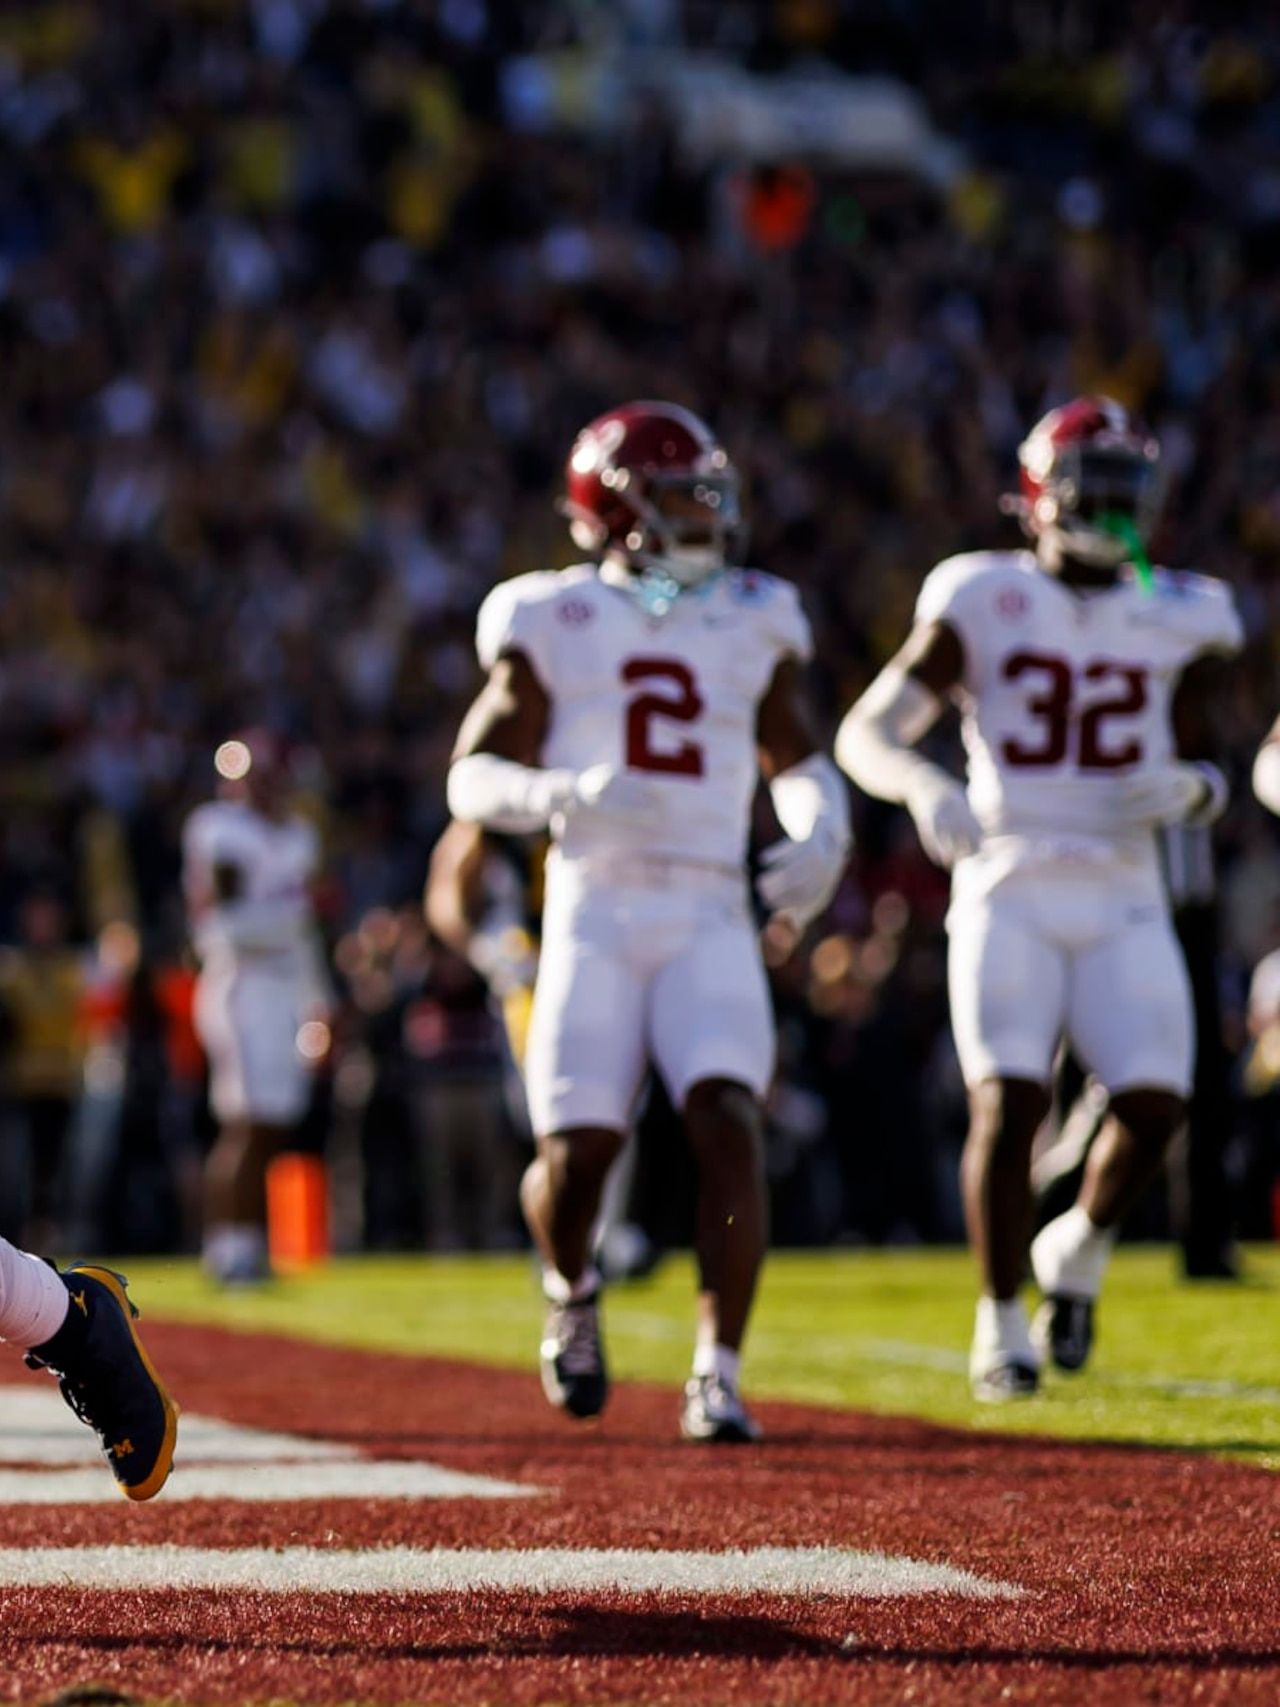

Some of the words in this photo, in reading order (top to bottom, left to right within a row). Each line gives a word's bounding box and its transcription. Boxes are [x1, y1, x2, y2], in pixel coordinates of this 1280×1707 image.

[622, 657, 703, 777] 2
[1001, 650, 1147, 775] 32
[112, 1438, 134, 1458] M
